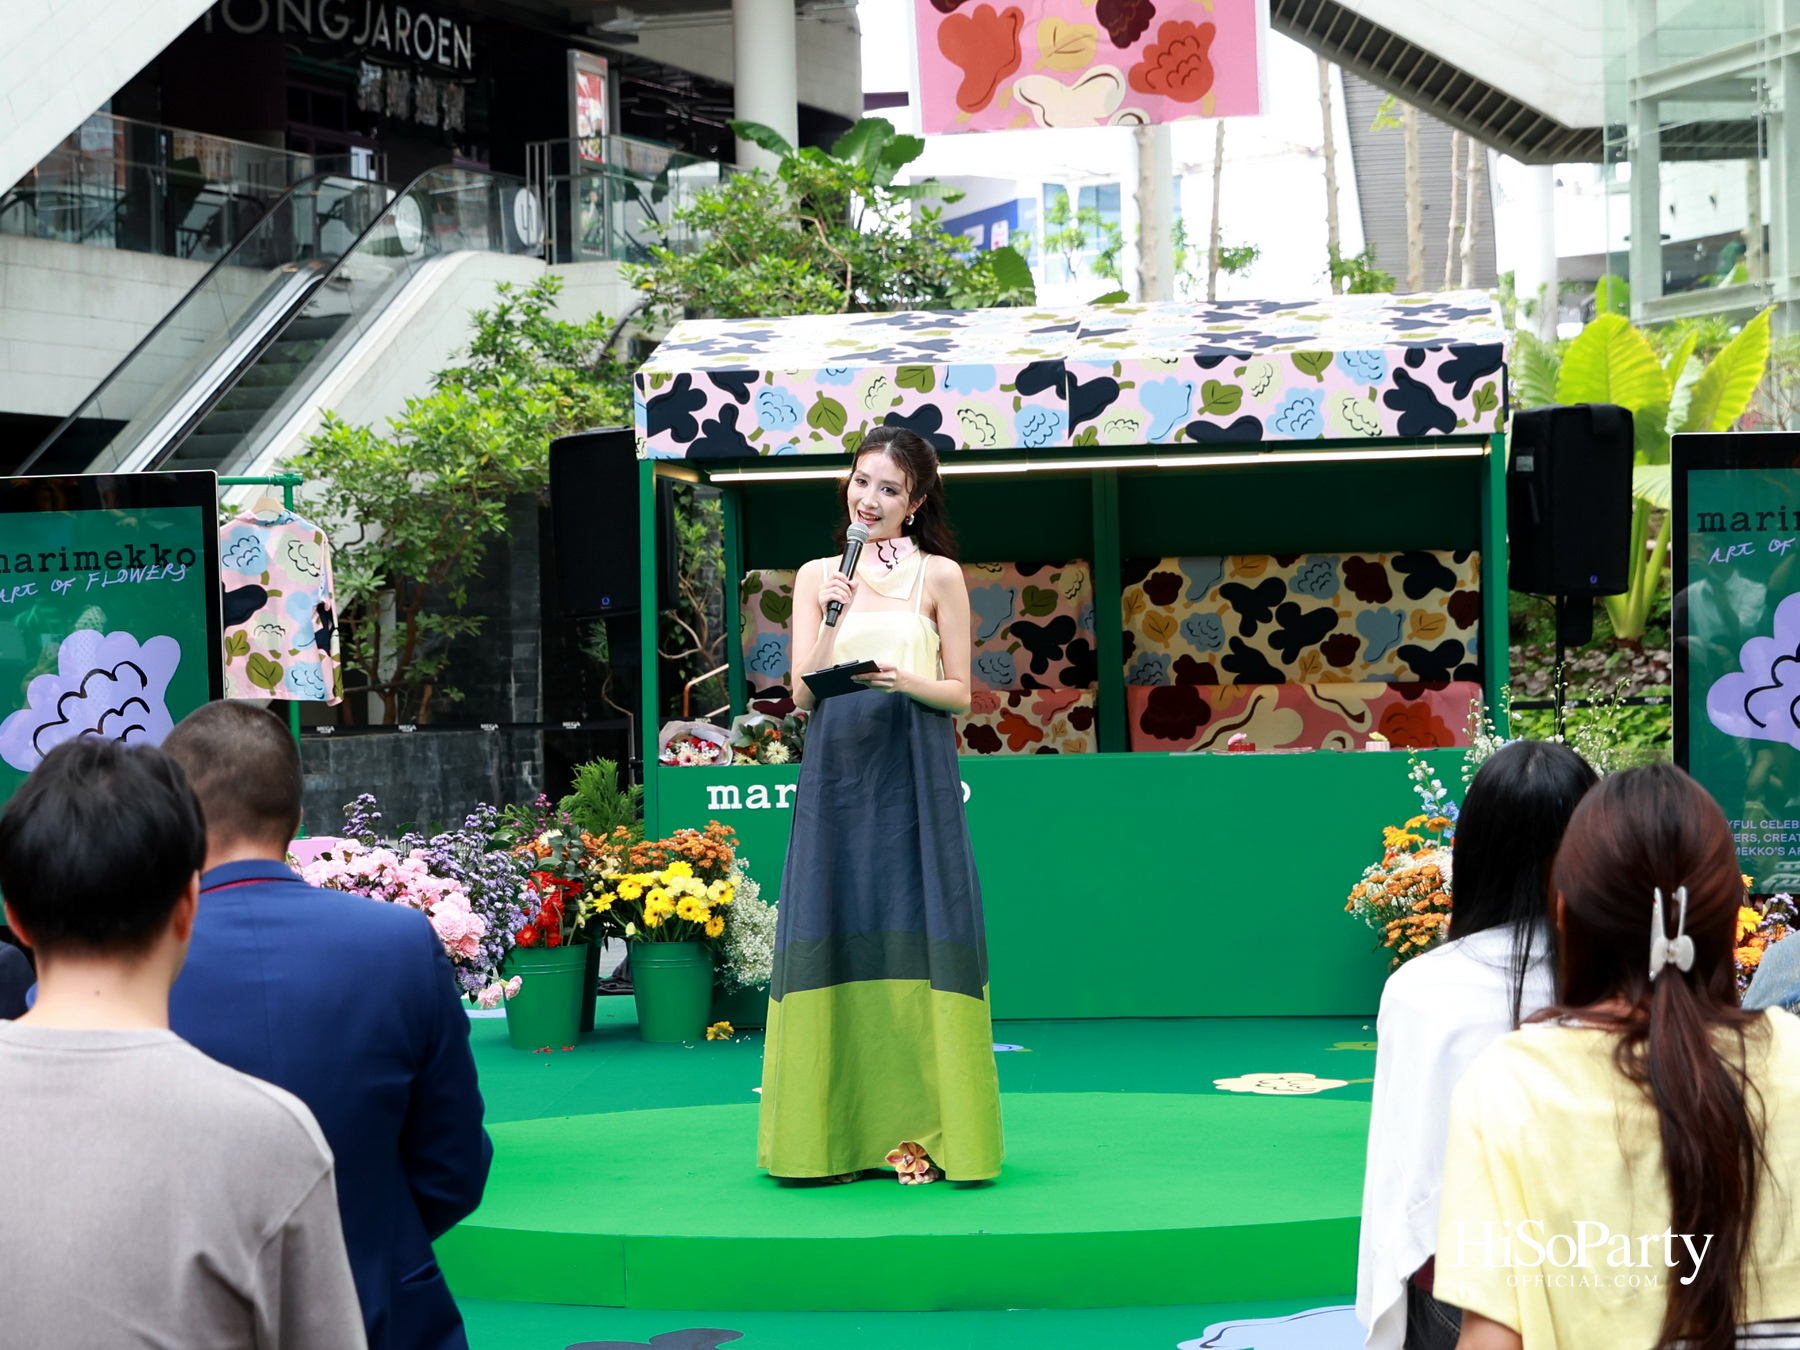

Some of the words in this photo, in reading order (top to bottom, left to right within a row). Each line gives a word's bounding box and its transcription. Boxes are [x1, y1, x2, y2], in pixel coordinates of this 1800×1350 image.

[1697, 505, 1800, 532] mari
[51, 577, 76, 596] OF
[85, 563, 186, 592] FLOWERS
[1732, 833, 1760, 844] ERS,
